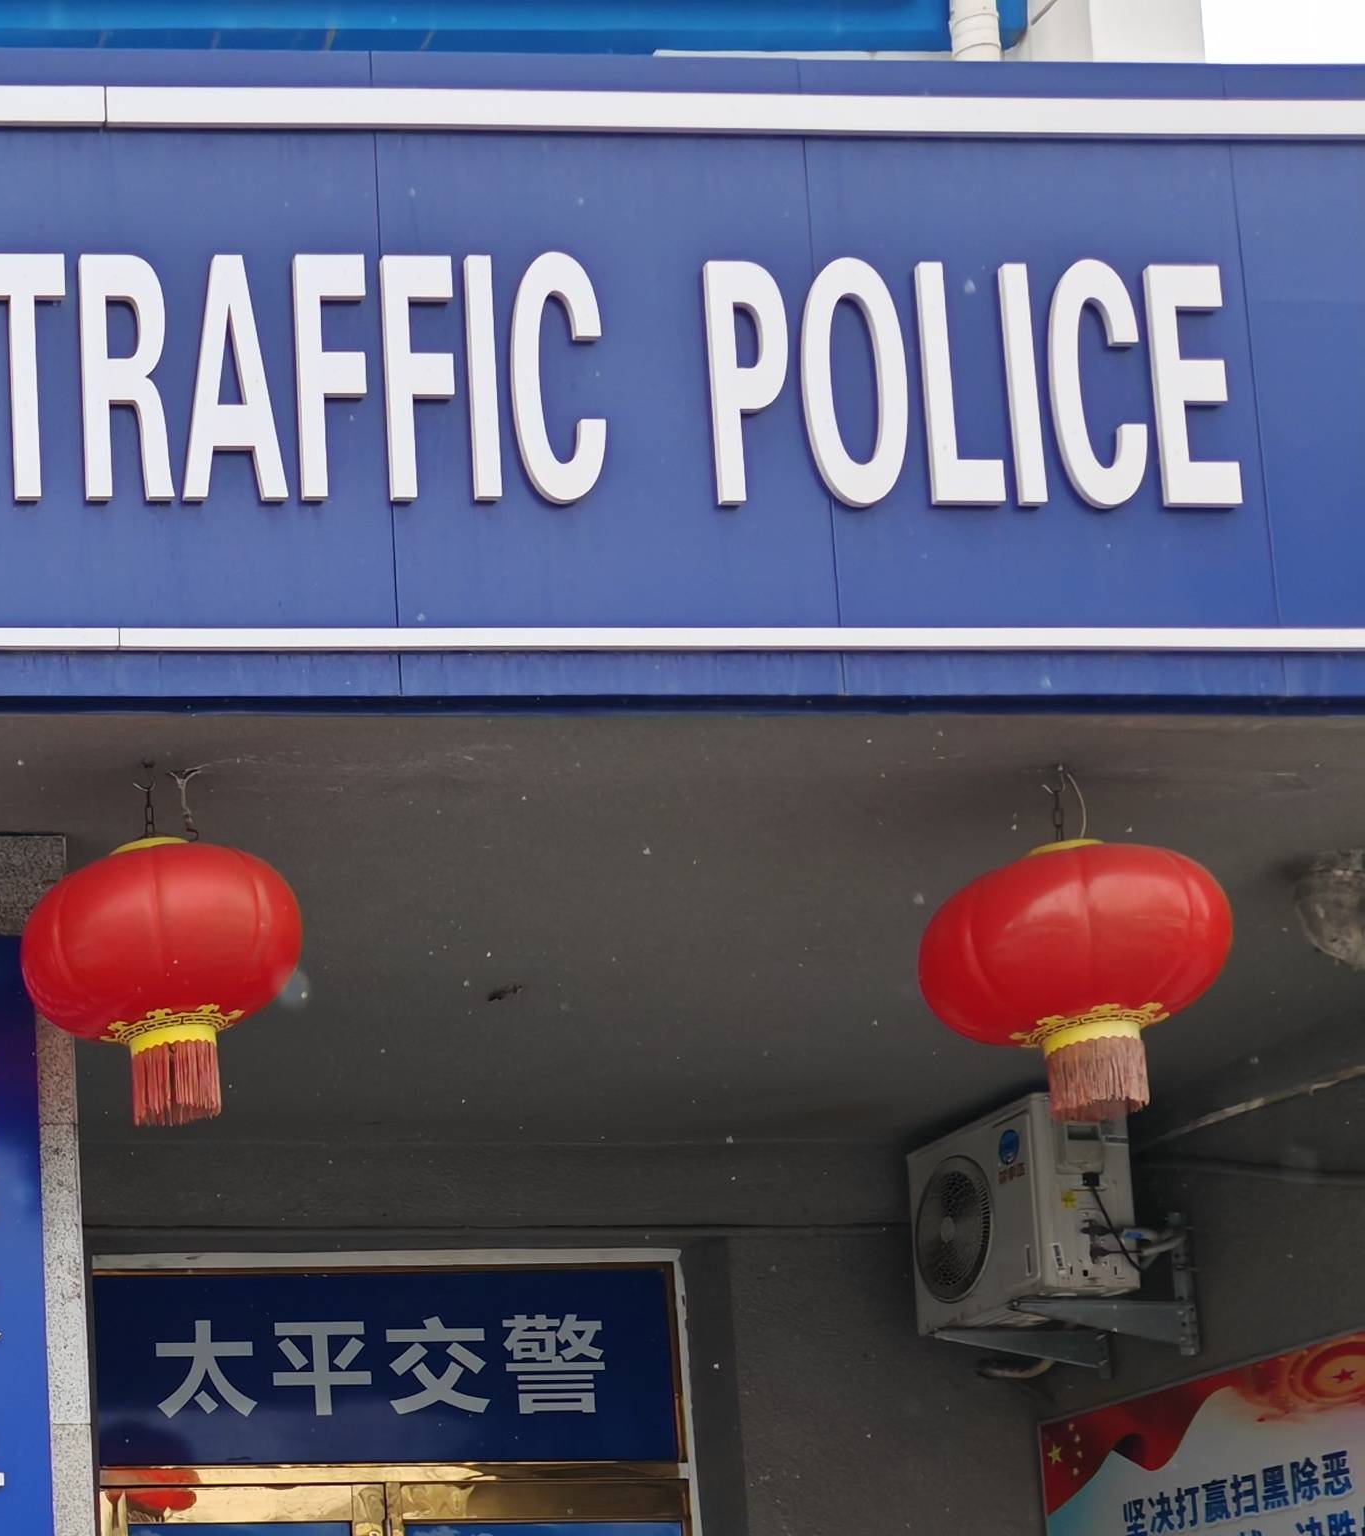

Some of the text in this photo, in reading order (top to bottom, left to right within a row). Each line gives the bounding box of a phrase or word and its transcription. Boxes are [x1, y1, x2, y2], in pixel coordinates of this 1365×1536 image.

[702, 256, 1244, 509] POLICE
[153, 1312, 607, 1419] 太平交警
